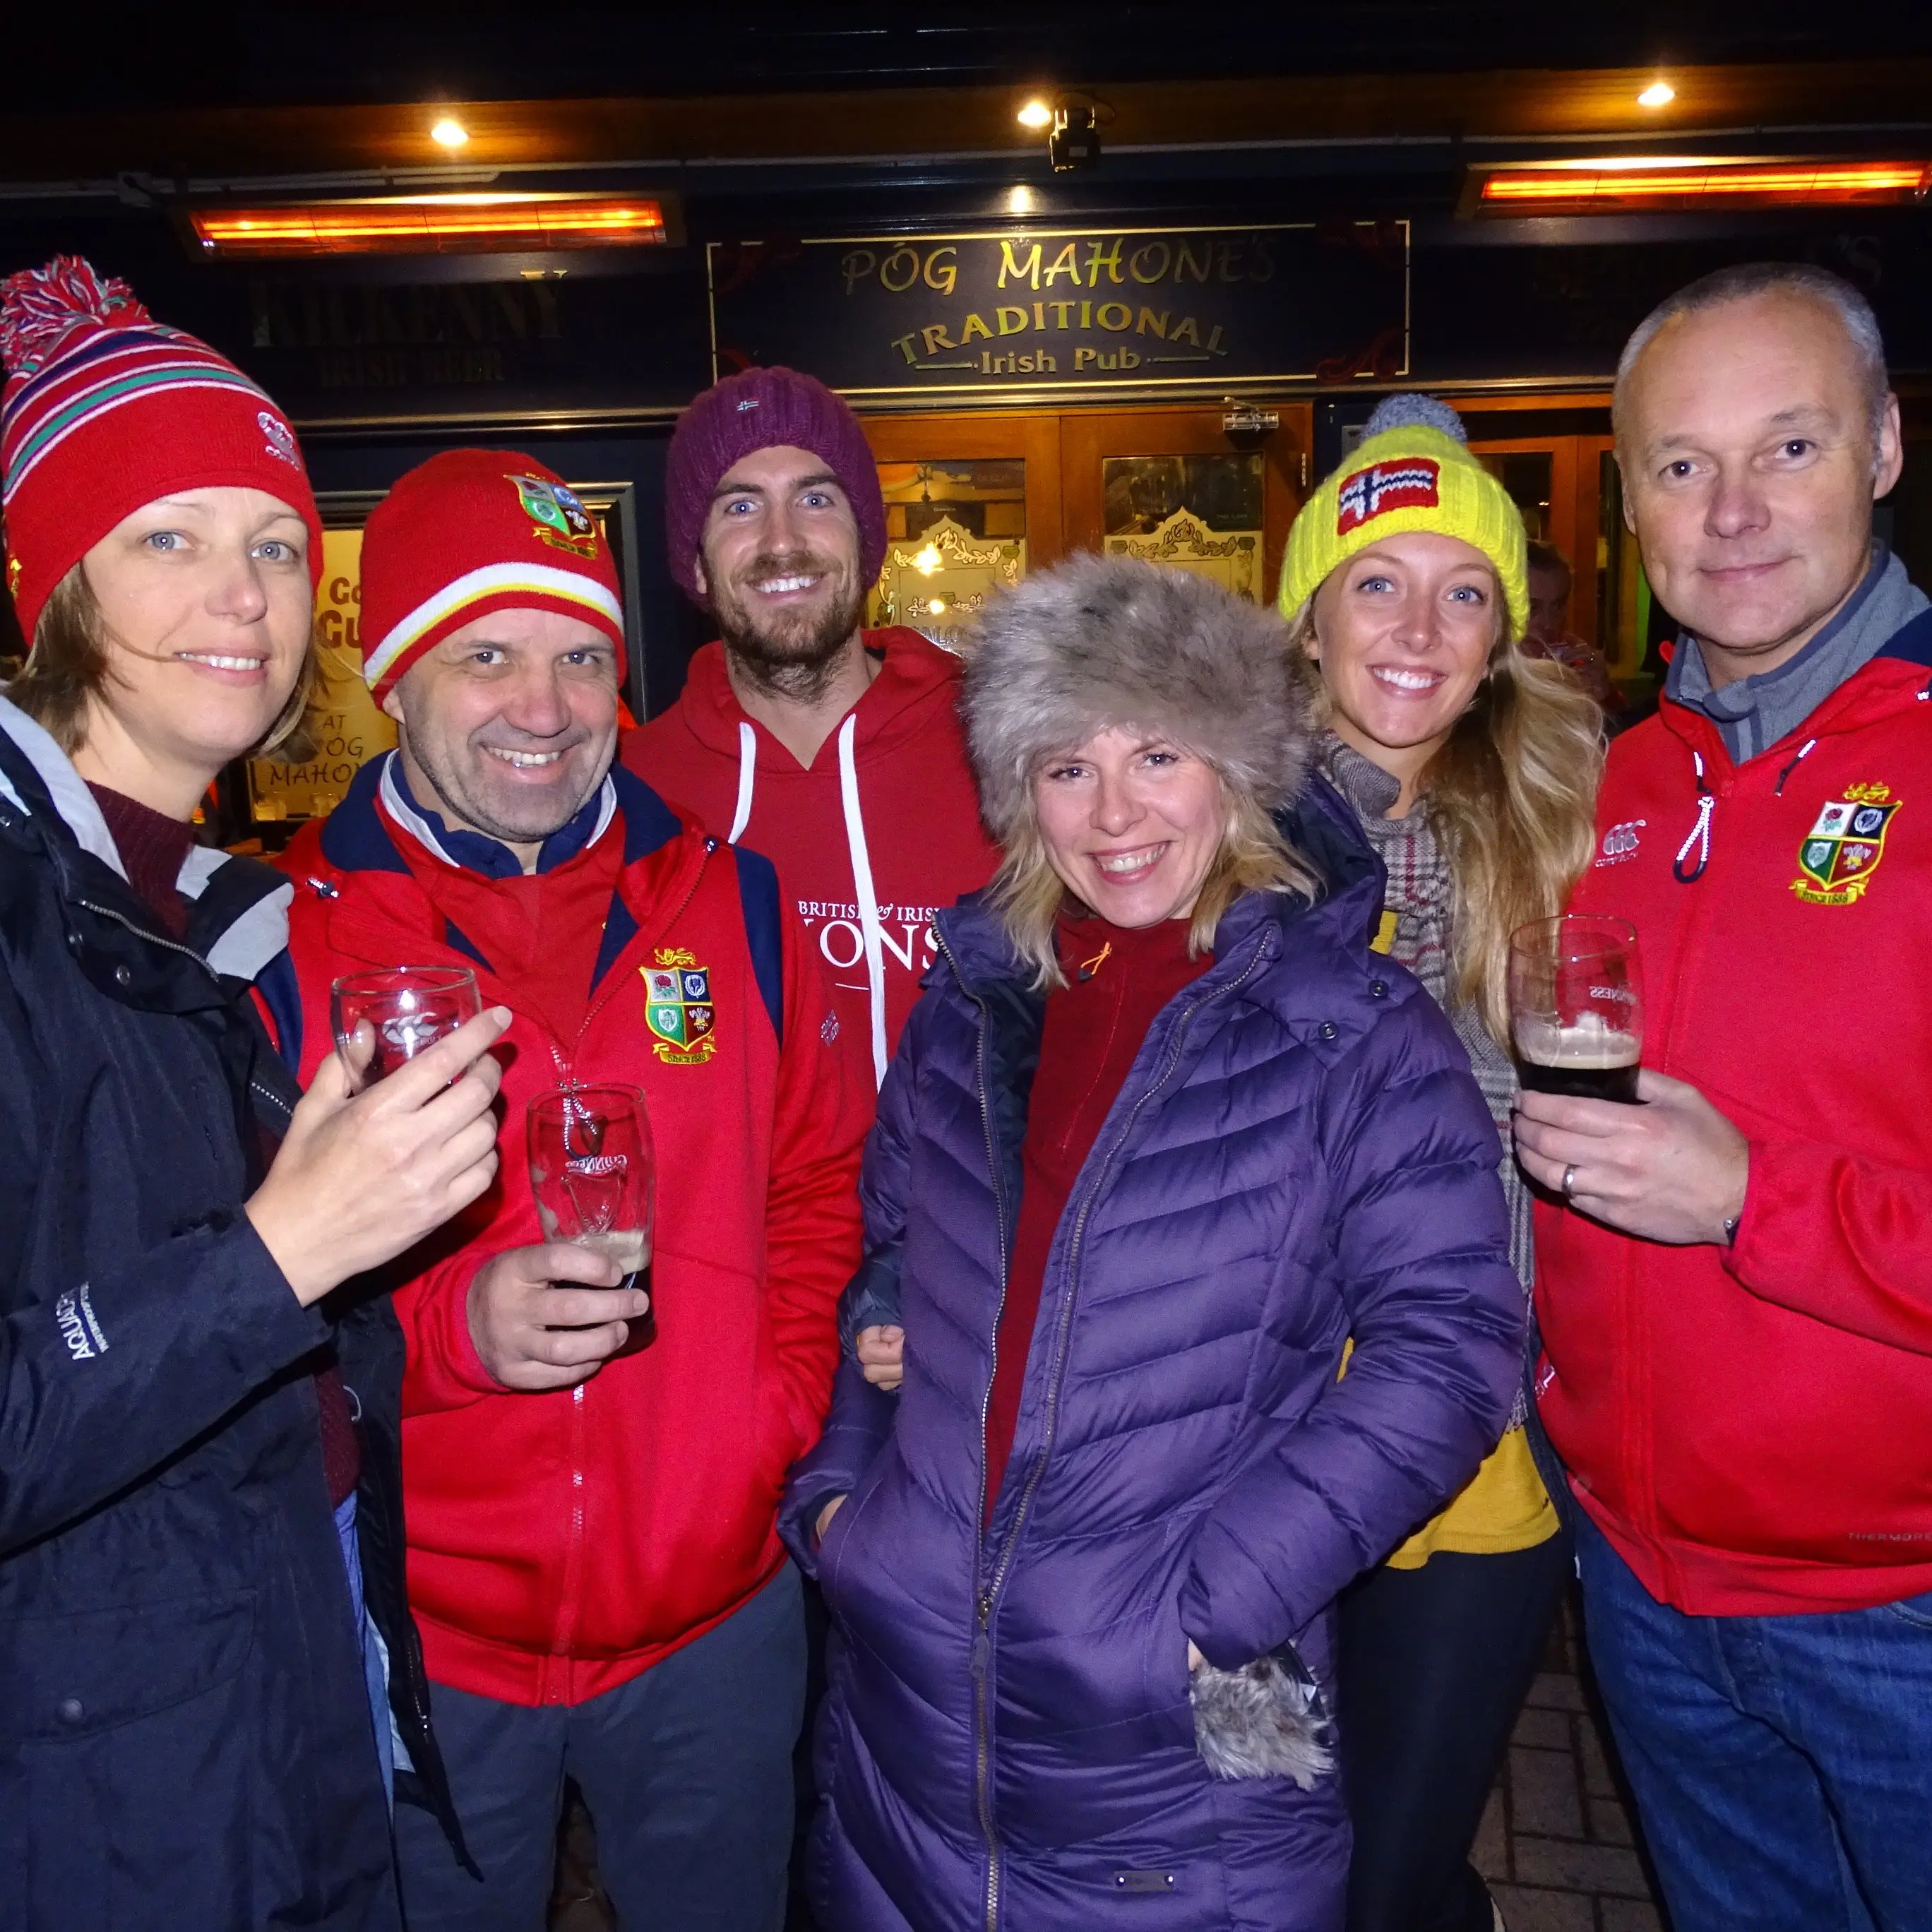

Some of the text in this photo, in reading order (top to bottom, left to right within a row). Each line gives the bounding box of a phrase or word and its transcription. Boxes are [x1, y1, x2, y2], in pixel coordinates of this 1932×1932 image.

[842, 242, 958, 295] PÓG
[891, 300, 1229, 365] TRADITIONAL
[982, 347, 1140, 374] Irish Pub
[322, 715, 347, 729] AT
[320, 732, 364, 759] ÓG
[270, 763, 362, 787] MAHO
[897, 906, 941, 922] IRIS
